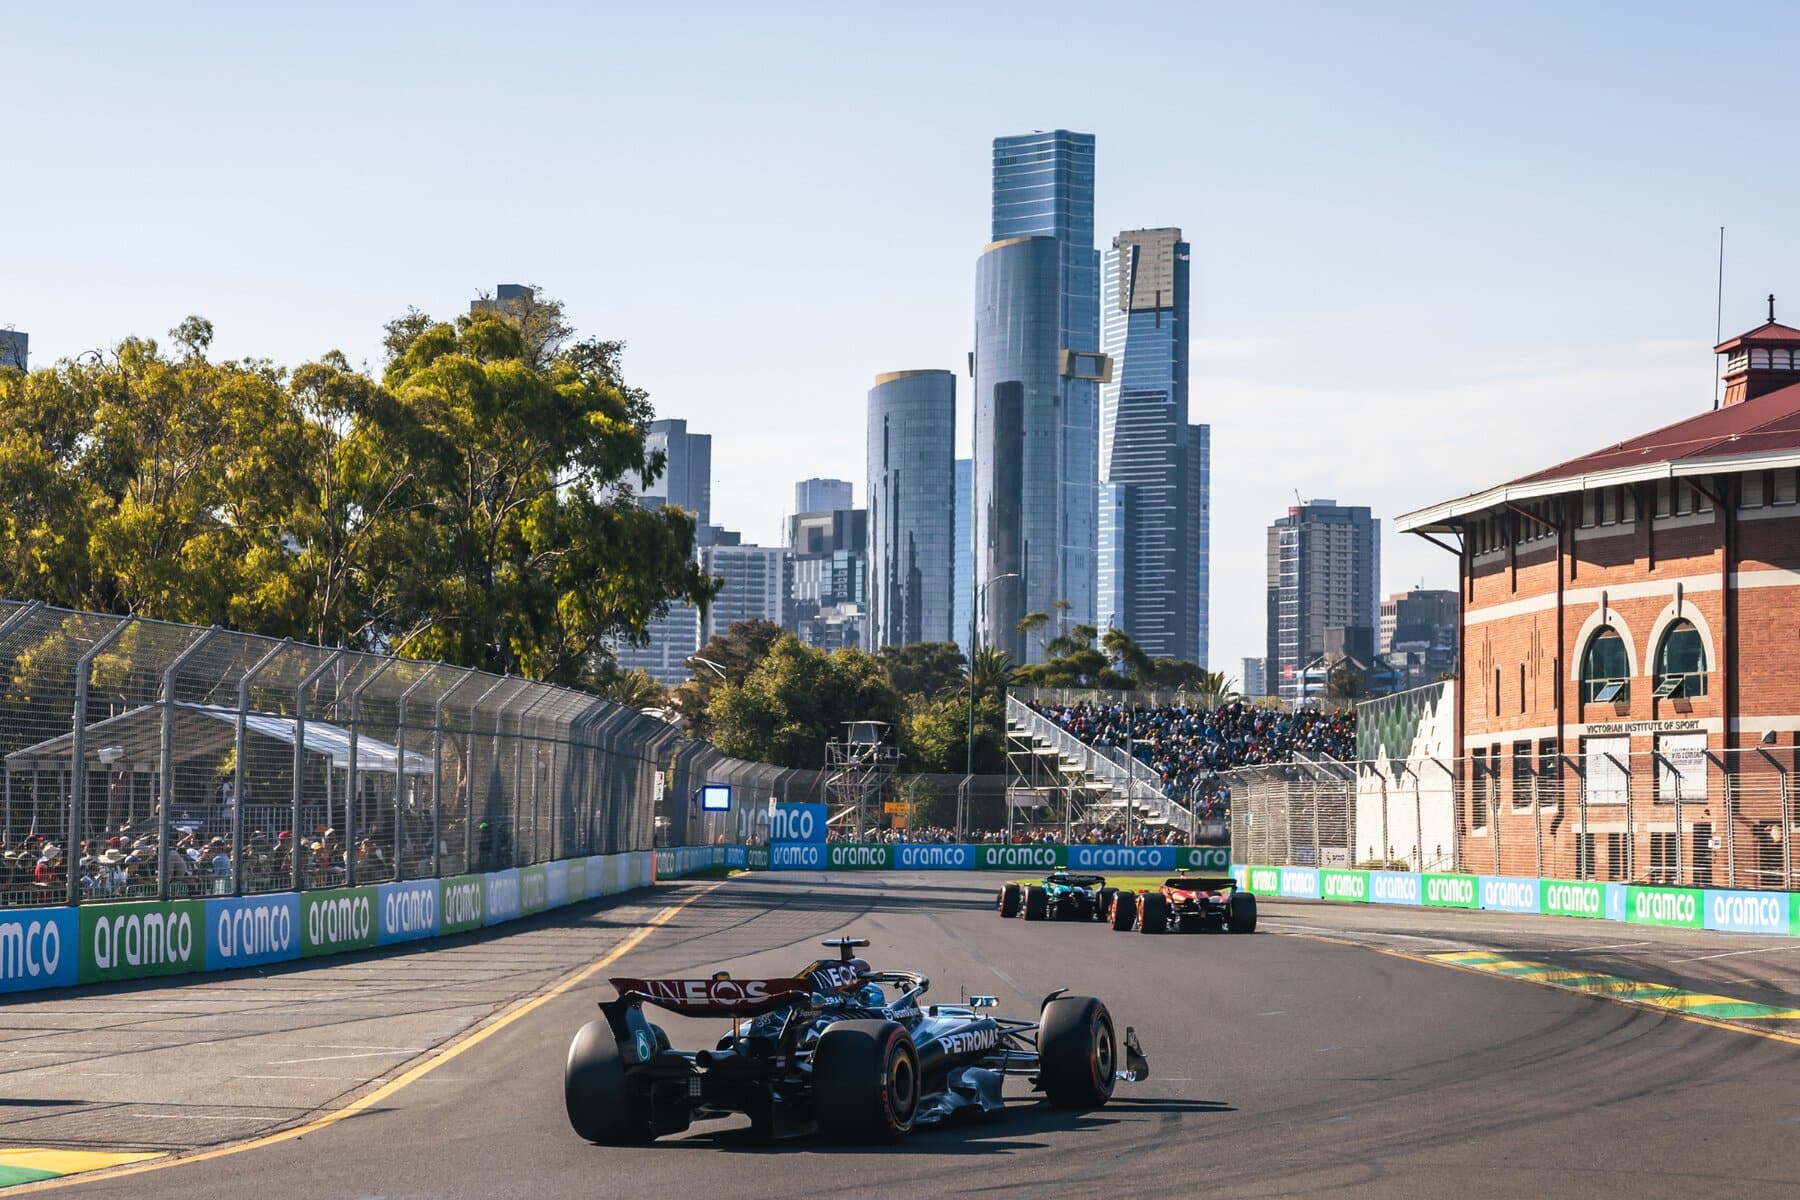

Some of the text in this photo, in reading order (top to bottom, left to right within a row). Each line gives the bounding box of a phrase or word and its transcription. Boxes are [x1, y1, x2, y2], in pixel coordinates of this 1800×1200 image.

[1586, 720, 1700, 734] VICTORIAN INSTITUTE OF SPORT
[774, 847, 818, 864] aramco
[832, 847, 886, 865] aramco
[903, 847, 965, 865] aramco
[986, 848, 1056, 865] aramco
[1080, 848, 1161, 866] aramco
[1189, 849, 1231, 866] ara
[1325, 874, 1364, 897] aramco
[1376, 877, 1416, 900] aramco
[1428, 878, 1473, 902] aramco
[1485, 881, 1533, 908] aramco
[445, 883, 481, 924] aramco
[1548, 884, 1599, 912] aramco
[1636, 892, 1695, 921] aramco
[309, 896, 369, 945] aramco
[386, 888, 434, 934] aramco
[1714, 896, 1780, 926] aramco
[95, 912, 192, 968] aramco
[218, 904, 290, 957] aramco
[812, 965, 858, 989] INEOS
[644, 981, 769, 1005] INEOS
